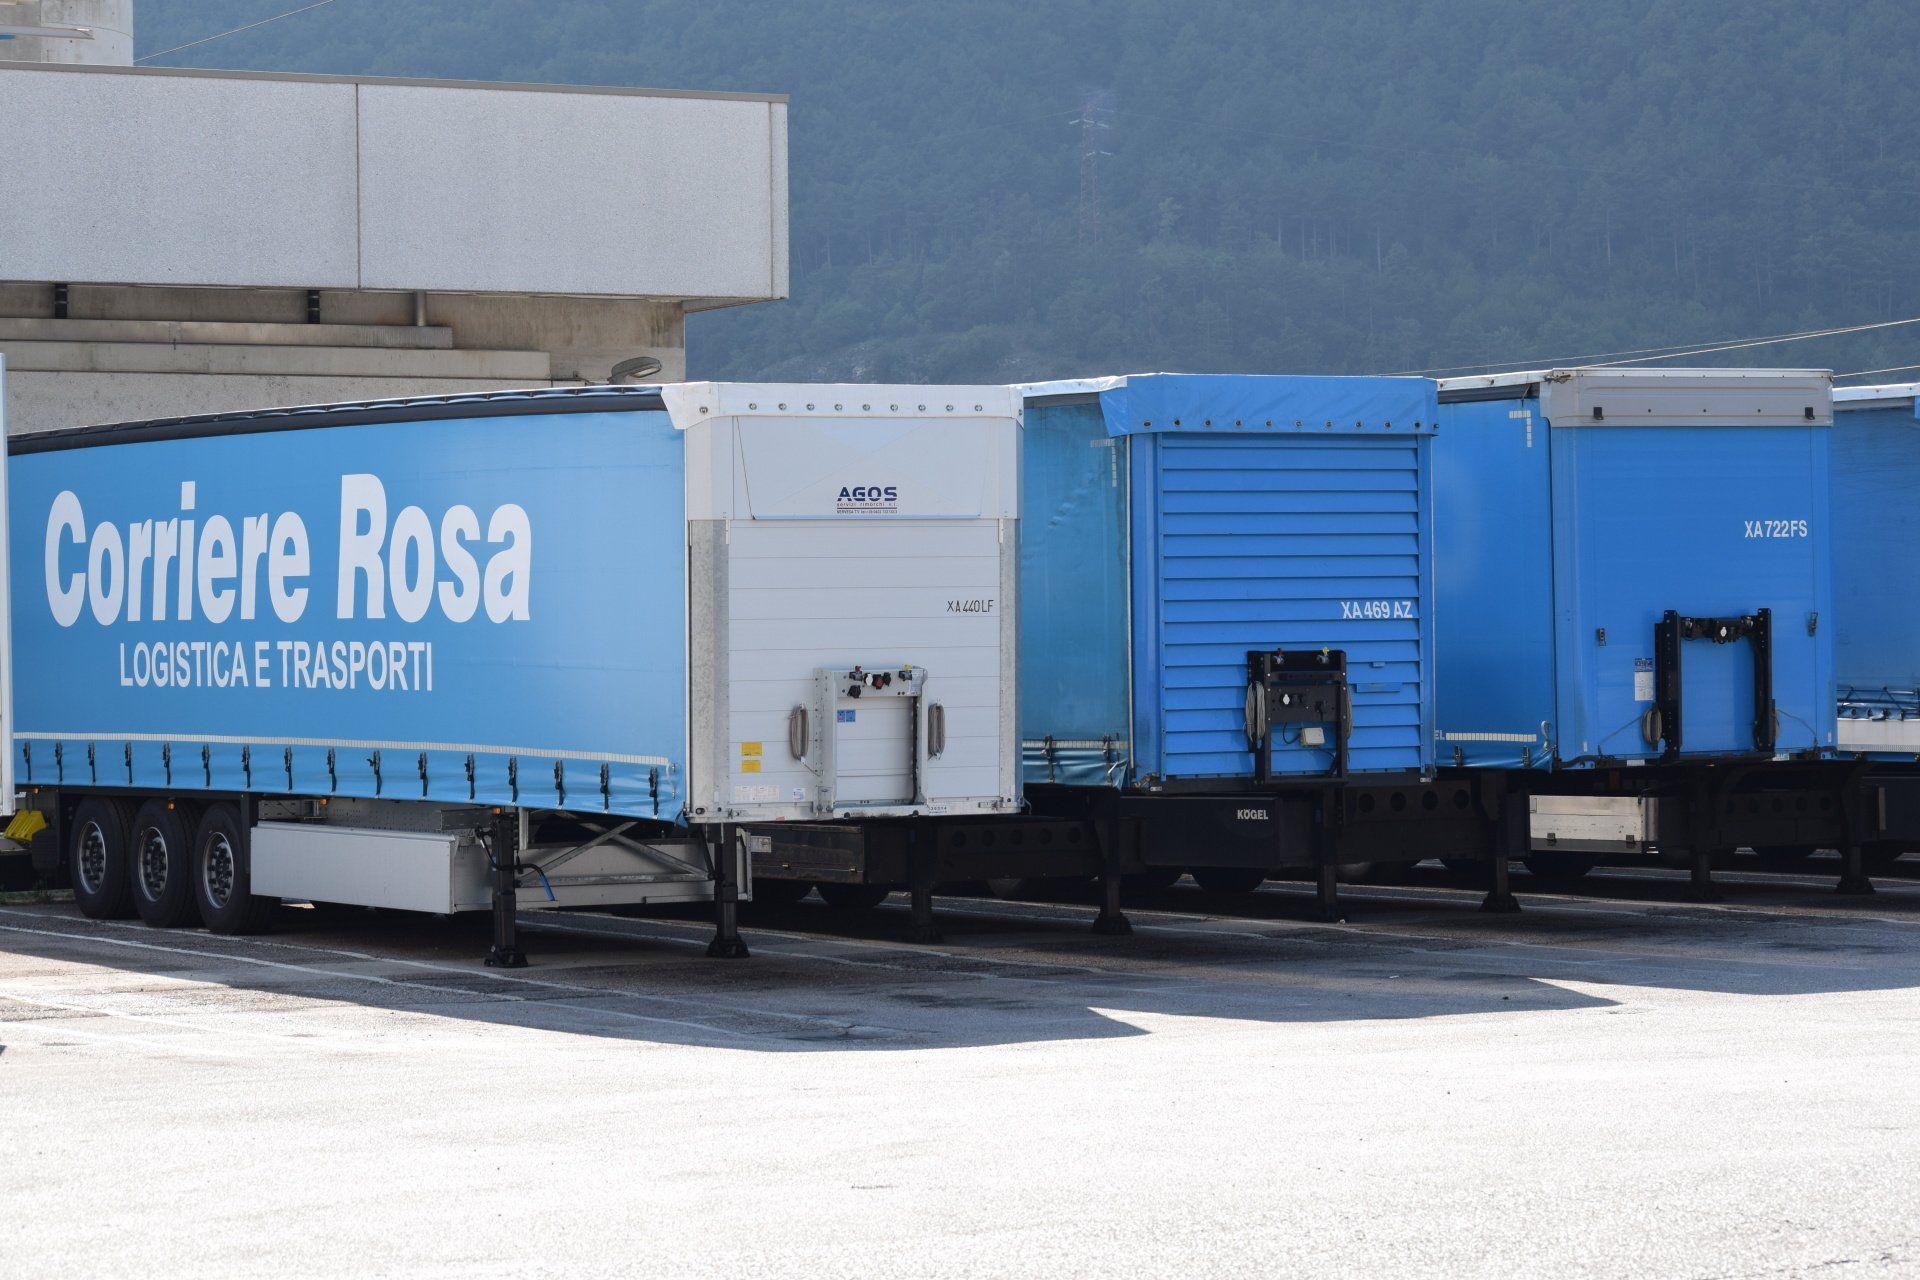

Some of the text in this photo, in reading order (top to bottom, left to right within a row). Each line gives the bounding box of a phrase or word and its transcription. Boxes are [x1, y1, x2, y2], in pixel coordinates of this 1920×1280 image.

[837, 486, 898, 502] AGOS
[45, 473, 532, 627] Corriere Rosa
[120, 640, 433, 692] LOGISTICA E TRASPORTI
